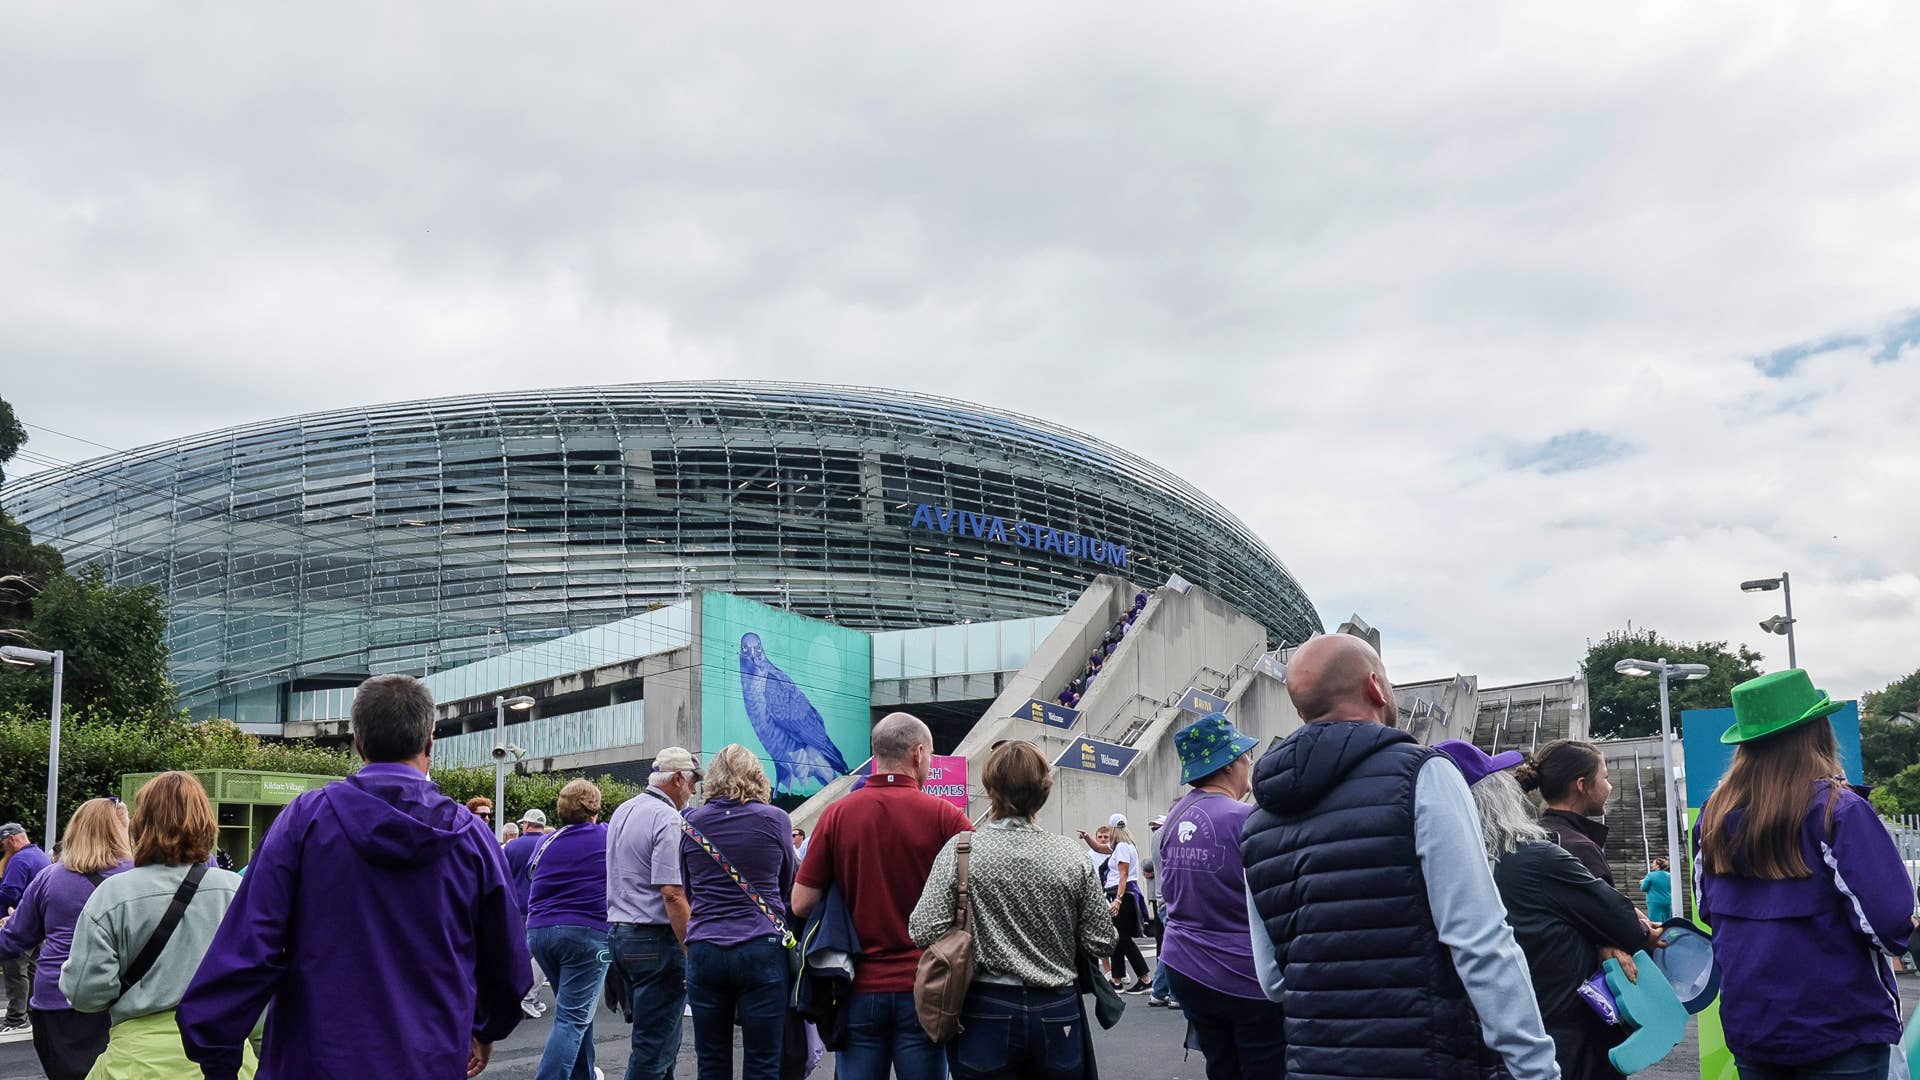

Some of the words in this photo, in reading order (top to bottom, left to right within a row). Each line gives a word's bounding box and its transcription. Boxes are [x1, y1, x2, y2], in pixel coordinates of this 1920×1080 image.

[911, 503, 1008, 543] AVIVA
[1014, 520, 1128, 568] STADIUM
[1100, 753, 1120, 767] Welcome
[264, 781, 285, 791] Kildare
[285, 782, 305, 793] Village
[1166, 847, 1209, 861] WILDCATS
